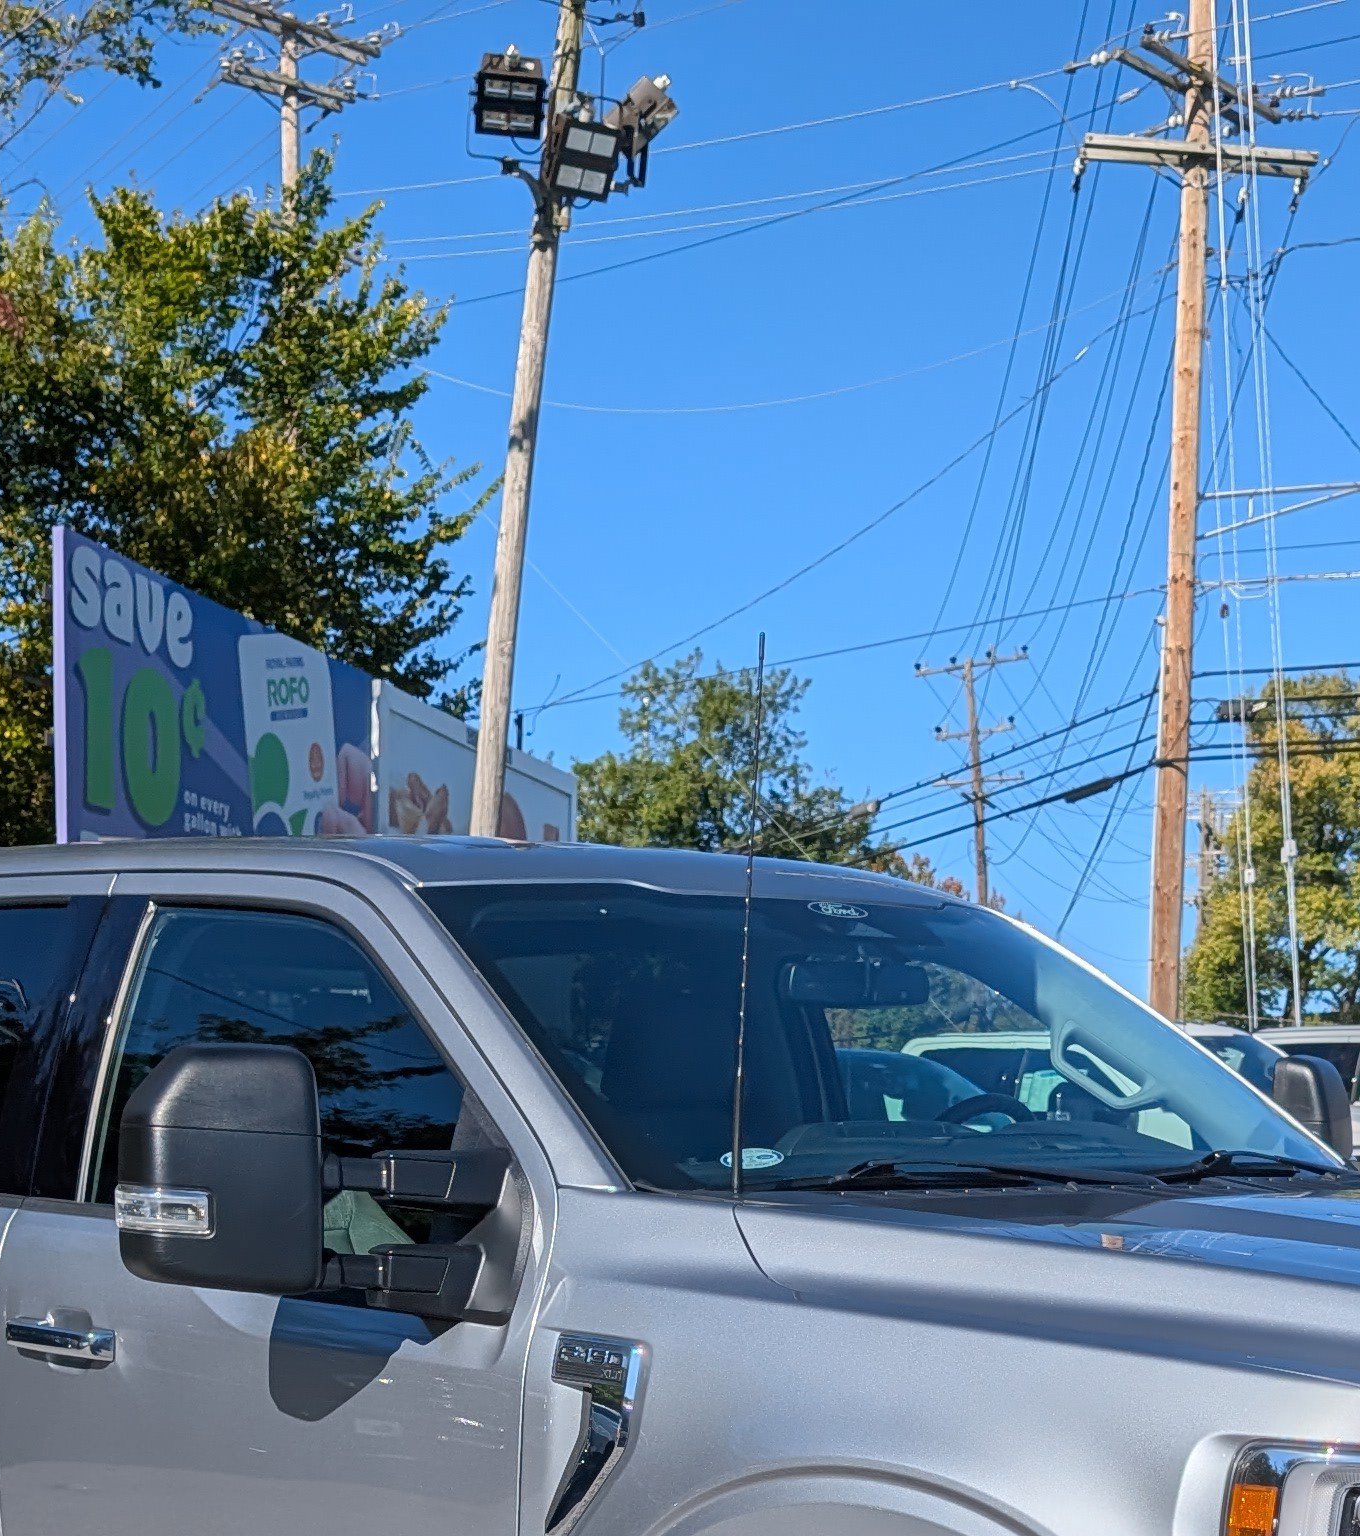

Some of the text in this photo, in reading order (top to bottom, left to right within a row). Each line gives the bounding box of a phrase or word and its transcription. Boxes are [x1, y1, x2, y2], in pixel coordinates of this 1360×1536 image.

[71, 545, 193, 668] save
[266, 676, 310, 707] ROFO
[183, 790, 230, 823] on every
[818, 902, 859, 917] Ford
